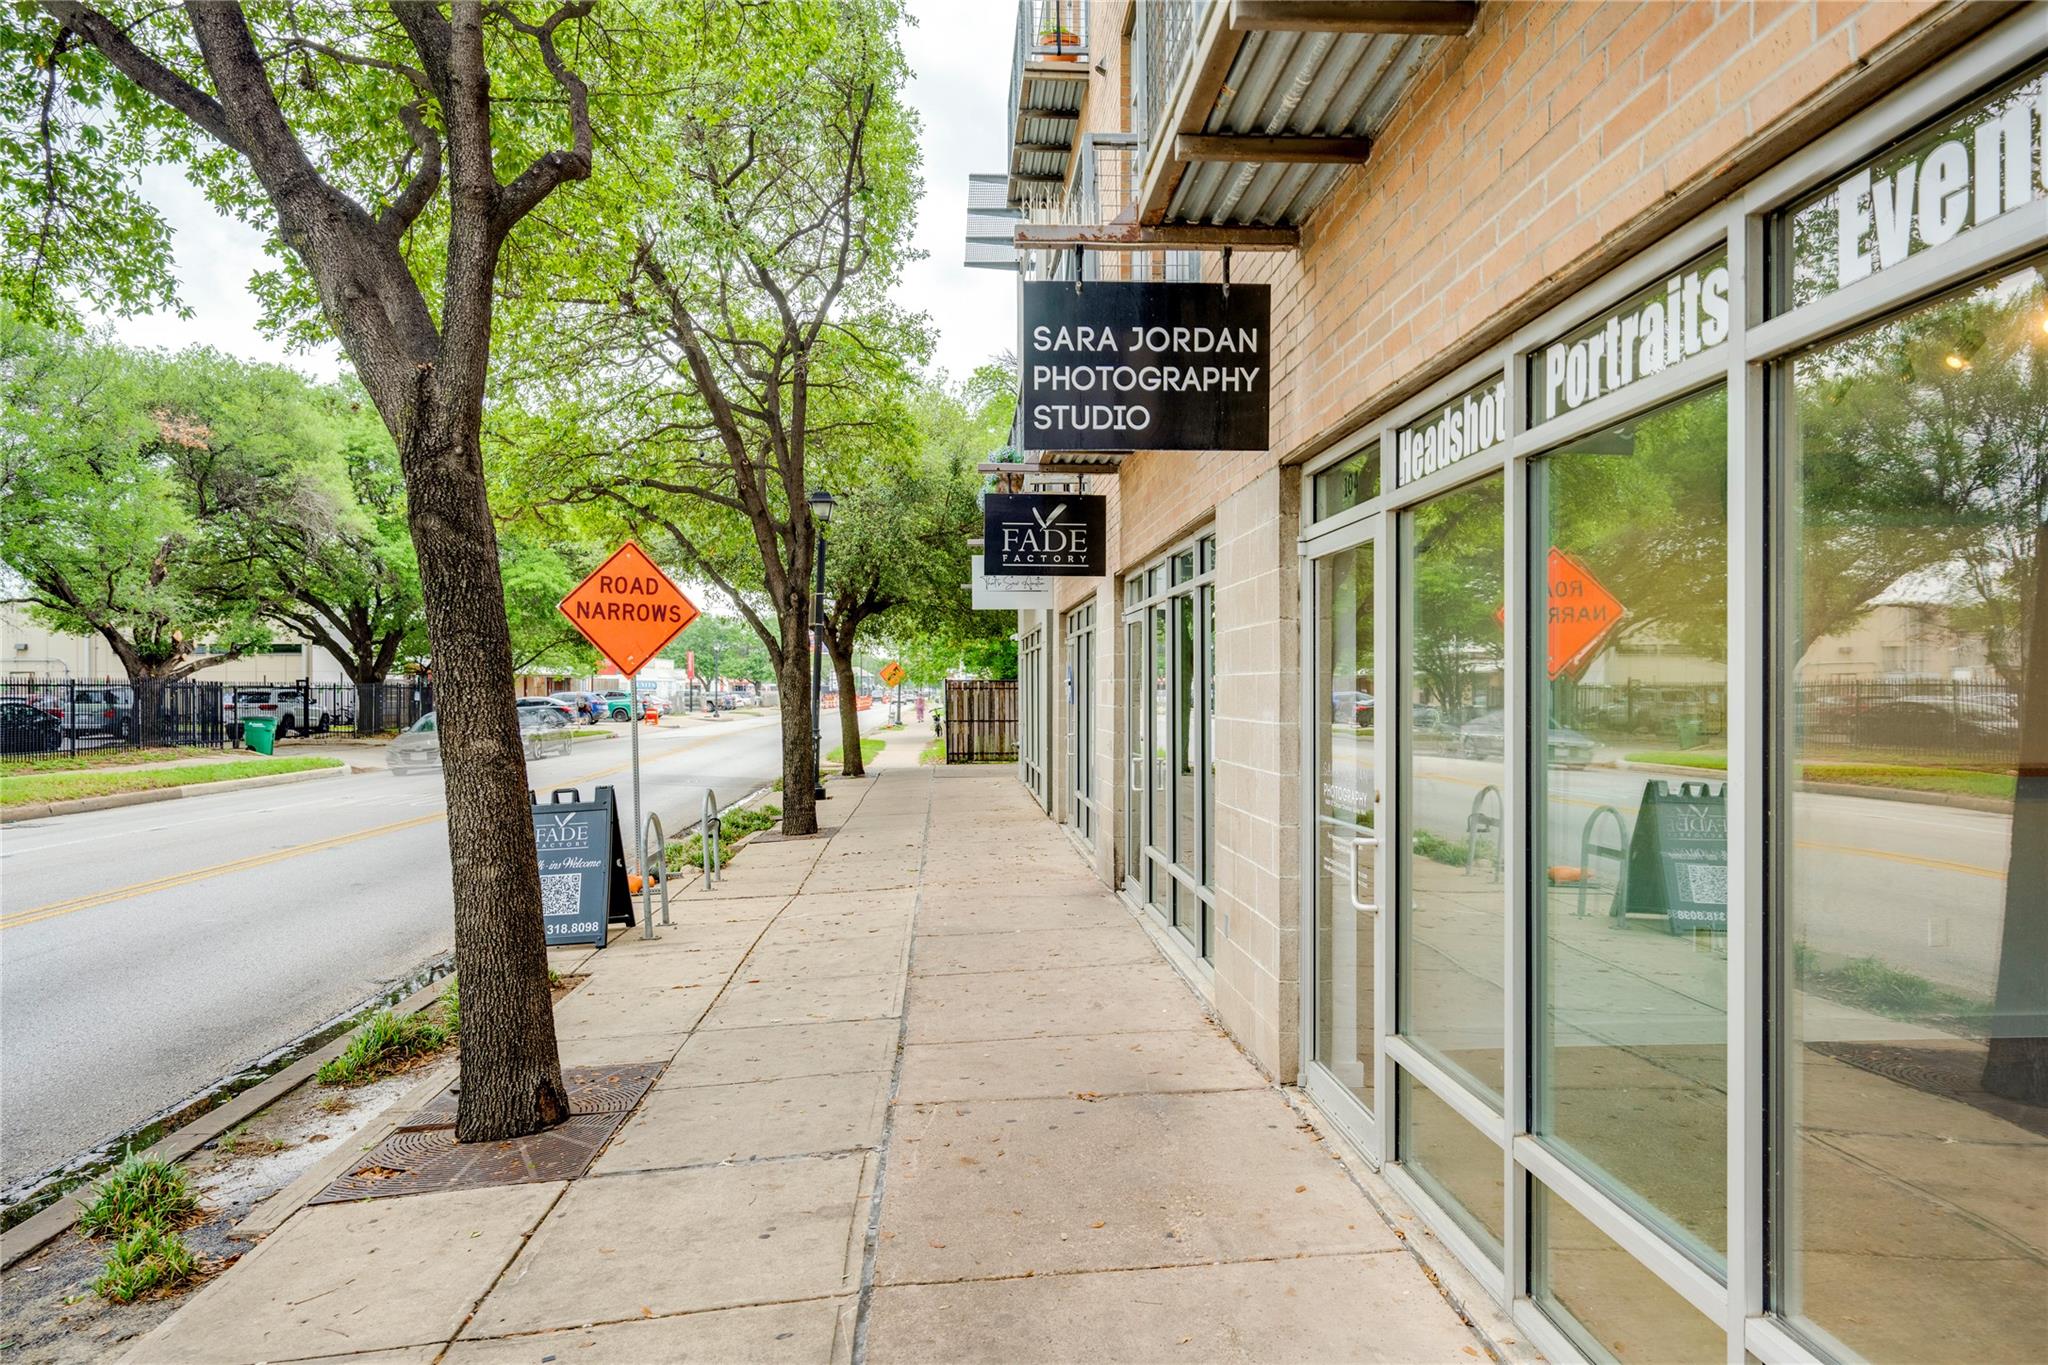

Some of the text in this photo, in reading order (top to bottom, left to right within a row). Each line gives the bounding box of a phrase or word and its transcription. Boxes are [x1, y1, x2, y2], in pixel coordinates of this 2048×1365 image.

[1033, 326, 1257, 353] SARA JORDAN
[1546, 267, 1728, 419] Portraits
[1033, 365, 1260, 392] PHOTOGRAPHY
[1033, 405, 1151, 431] STUDIO
[1399, 381, 1505, 487] Headshot
[1344, 470, 1359, 497] 104
[1002, 527, 1088, 553] FADE
[1003, 554, 1088, 563] FACTORY
[600, 576, 659, 595] ROAD
[577, 601, 681, 623] NARROWS
[536, 826, 588, 842] FADE
[537, 857, 601, 870] lk-ins Welcome
[546, 922, 599, 934] 318.8098
